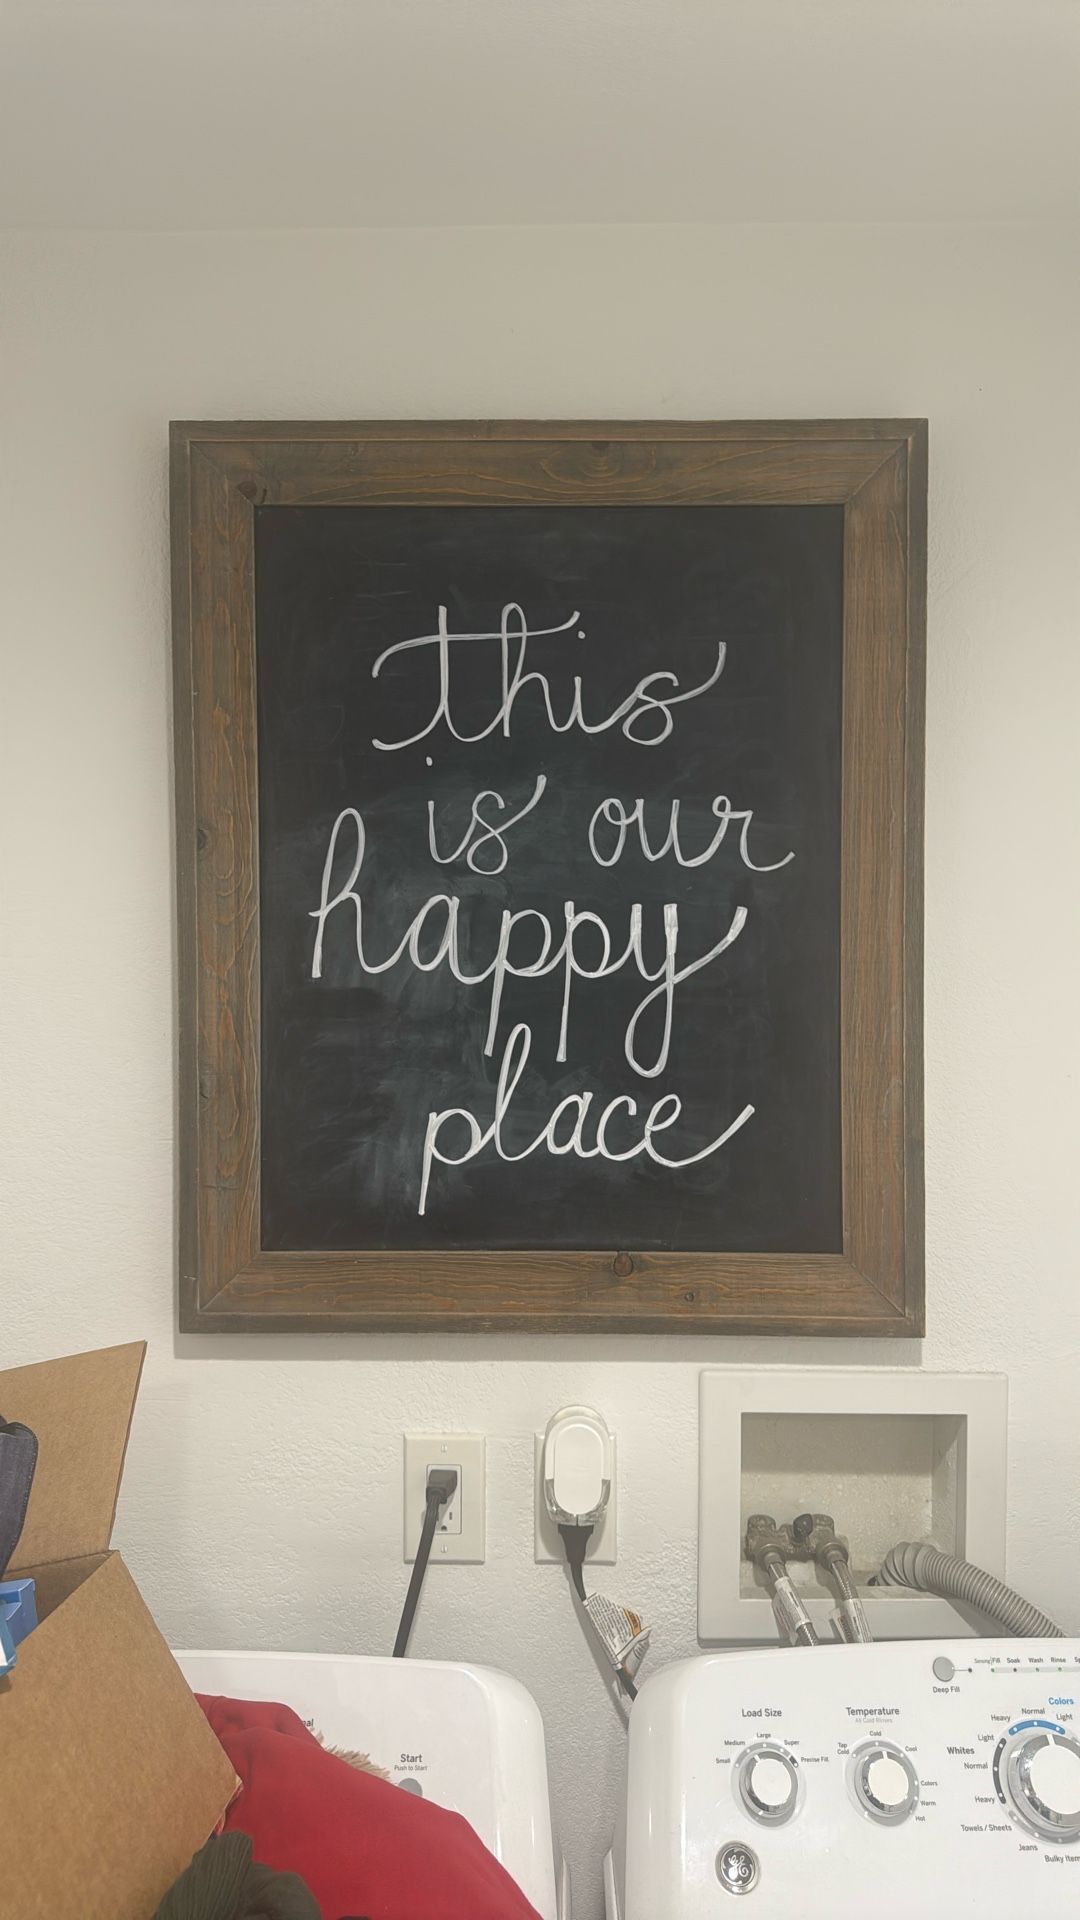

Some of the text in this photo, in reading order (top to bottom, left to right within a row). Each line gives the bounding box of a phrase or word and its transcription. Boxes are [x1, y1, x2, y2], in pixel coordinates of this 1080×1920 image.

[371, 602, 727, 751] this
[425, 755, 796, 876] is our
[308, 807, 749, 1079] happy
[417, 1022, 757, 1216] place
[932, 1685, 961, 1694] Deep Fill
[1048, 1697, 1074, 1706] Colors
[741, 1708, 783, 1718] Load Size
[846, 1707, 900, 1718] Temperature
[1021, 1707, 1046, 1715] Normal
[991, 1714, 1011, 1723] Heavy
[1056, 1713, 1073, 1721] Light
[977, 1733, 995, 1742] Light
[946, 1746, 975, 1755] Whites
[400, 1753, 423, 1763] Start
[393, 1764, 408, 1772] Push
[414, 1764, 428, 1772] Start
[963, 1762, 989, 1770] Normal
[974, 1796, 995, 1804] Heavy
[960, 1824, 984, 1832] Towels
[988, 1824, 1013, 1832] Sheets
[1018, 1844, 1038, 1852] Jeans
[1044, 1855, 1064, 1864] Bulky
